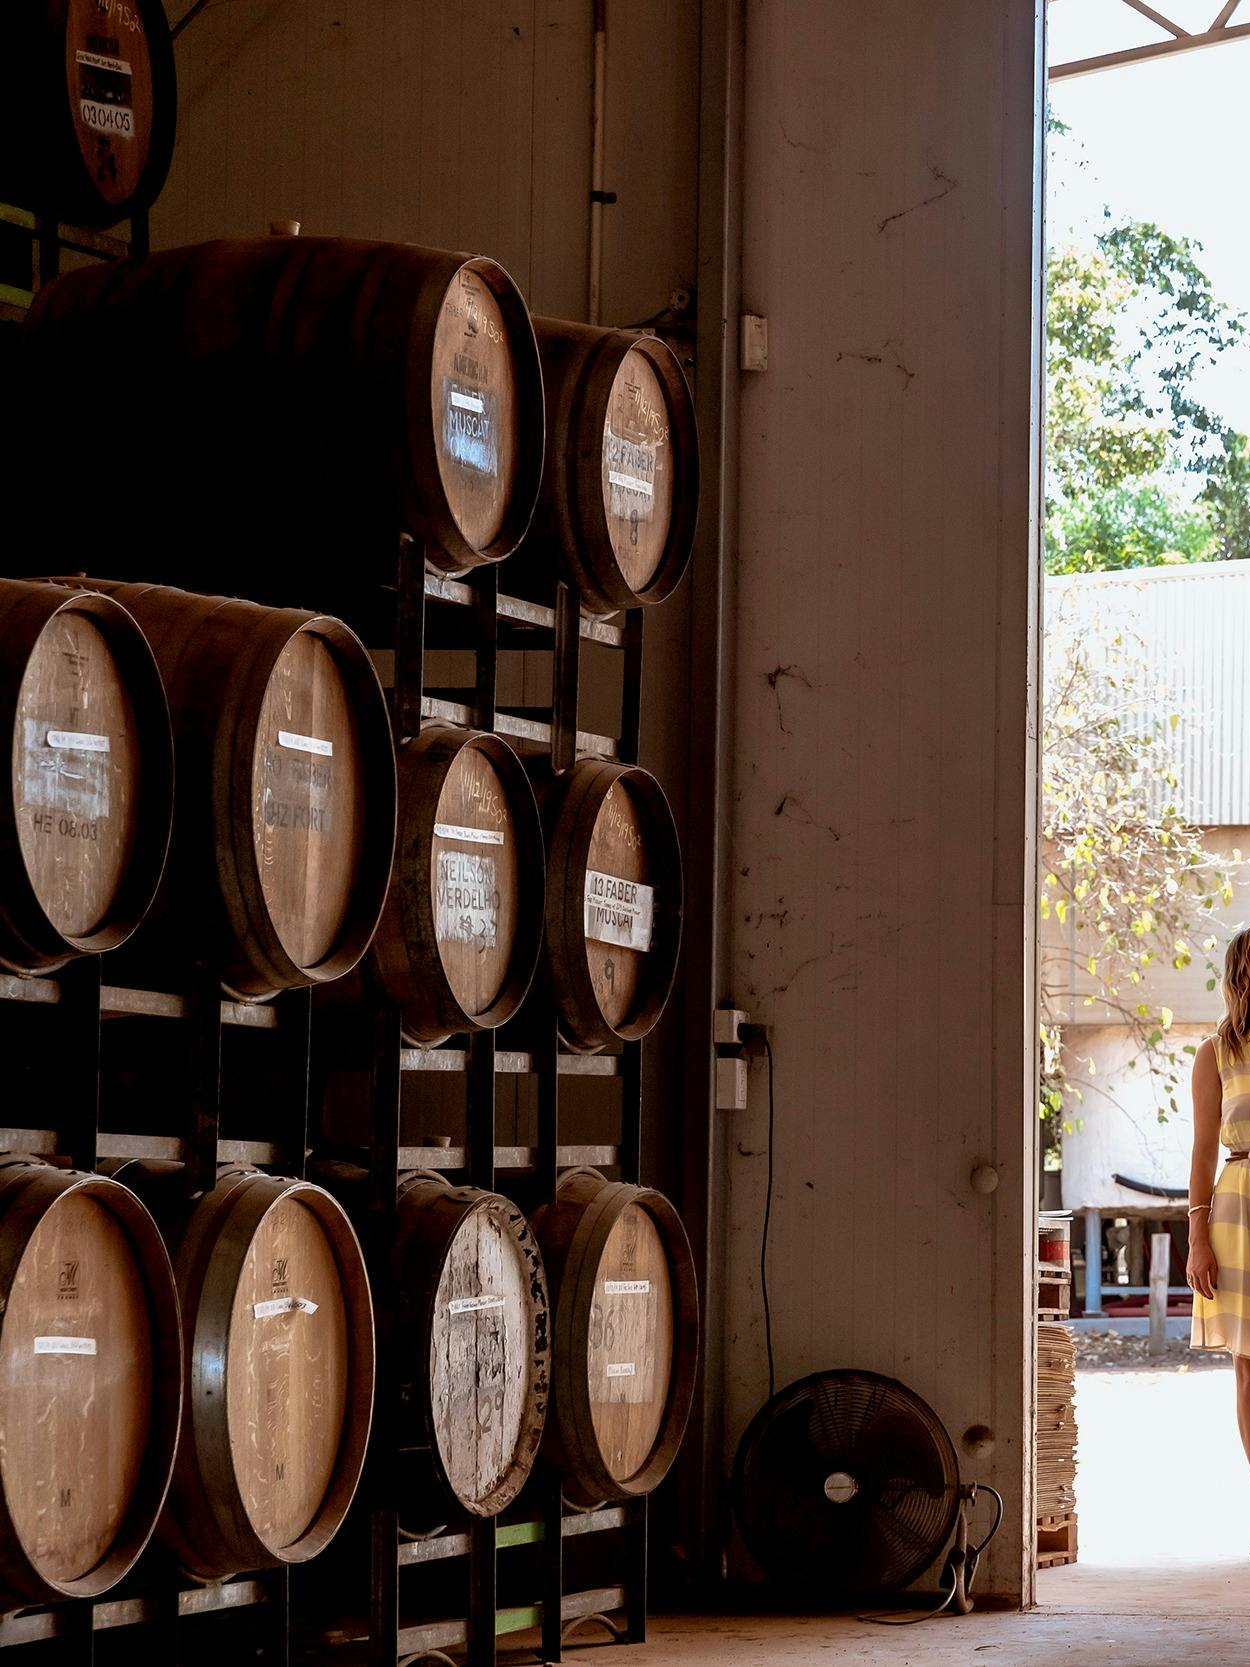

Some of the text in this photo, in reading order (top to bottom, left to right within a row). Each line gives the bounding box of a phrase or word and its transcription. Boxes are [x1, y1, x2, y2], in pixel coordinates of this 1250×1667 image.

[82, 104, 131, 132] 030405
[449, 409, 491, 441] MUSCAT
[440, 859, 493, 885] NEILSON
[437, 887, 501, 911] VERDELHO
[593, 877, 638, 904] 13 FABER
[604, 958, 615, 996] 9
[275, 1463, 285, 1481] M
